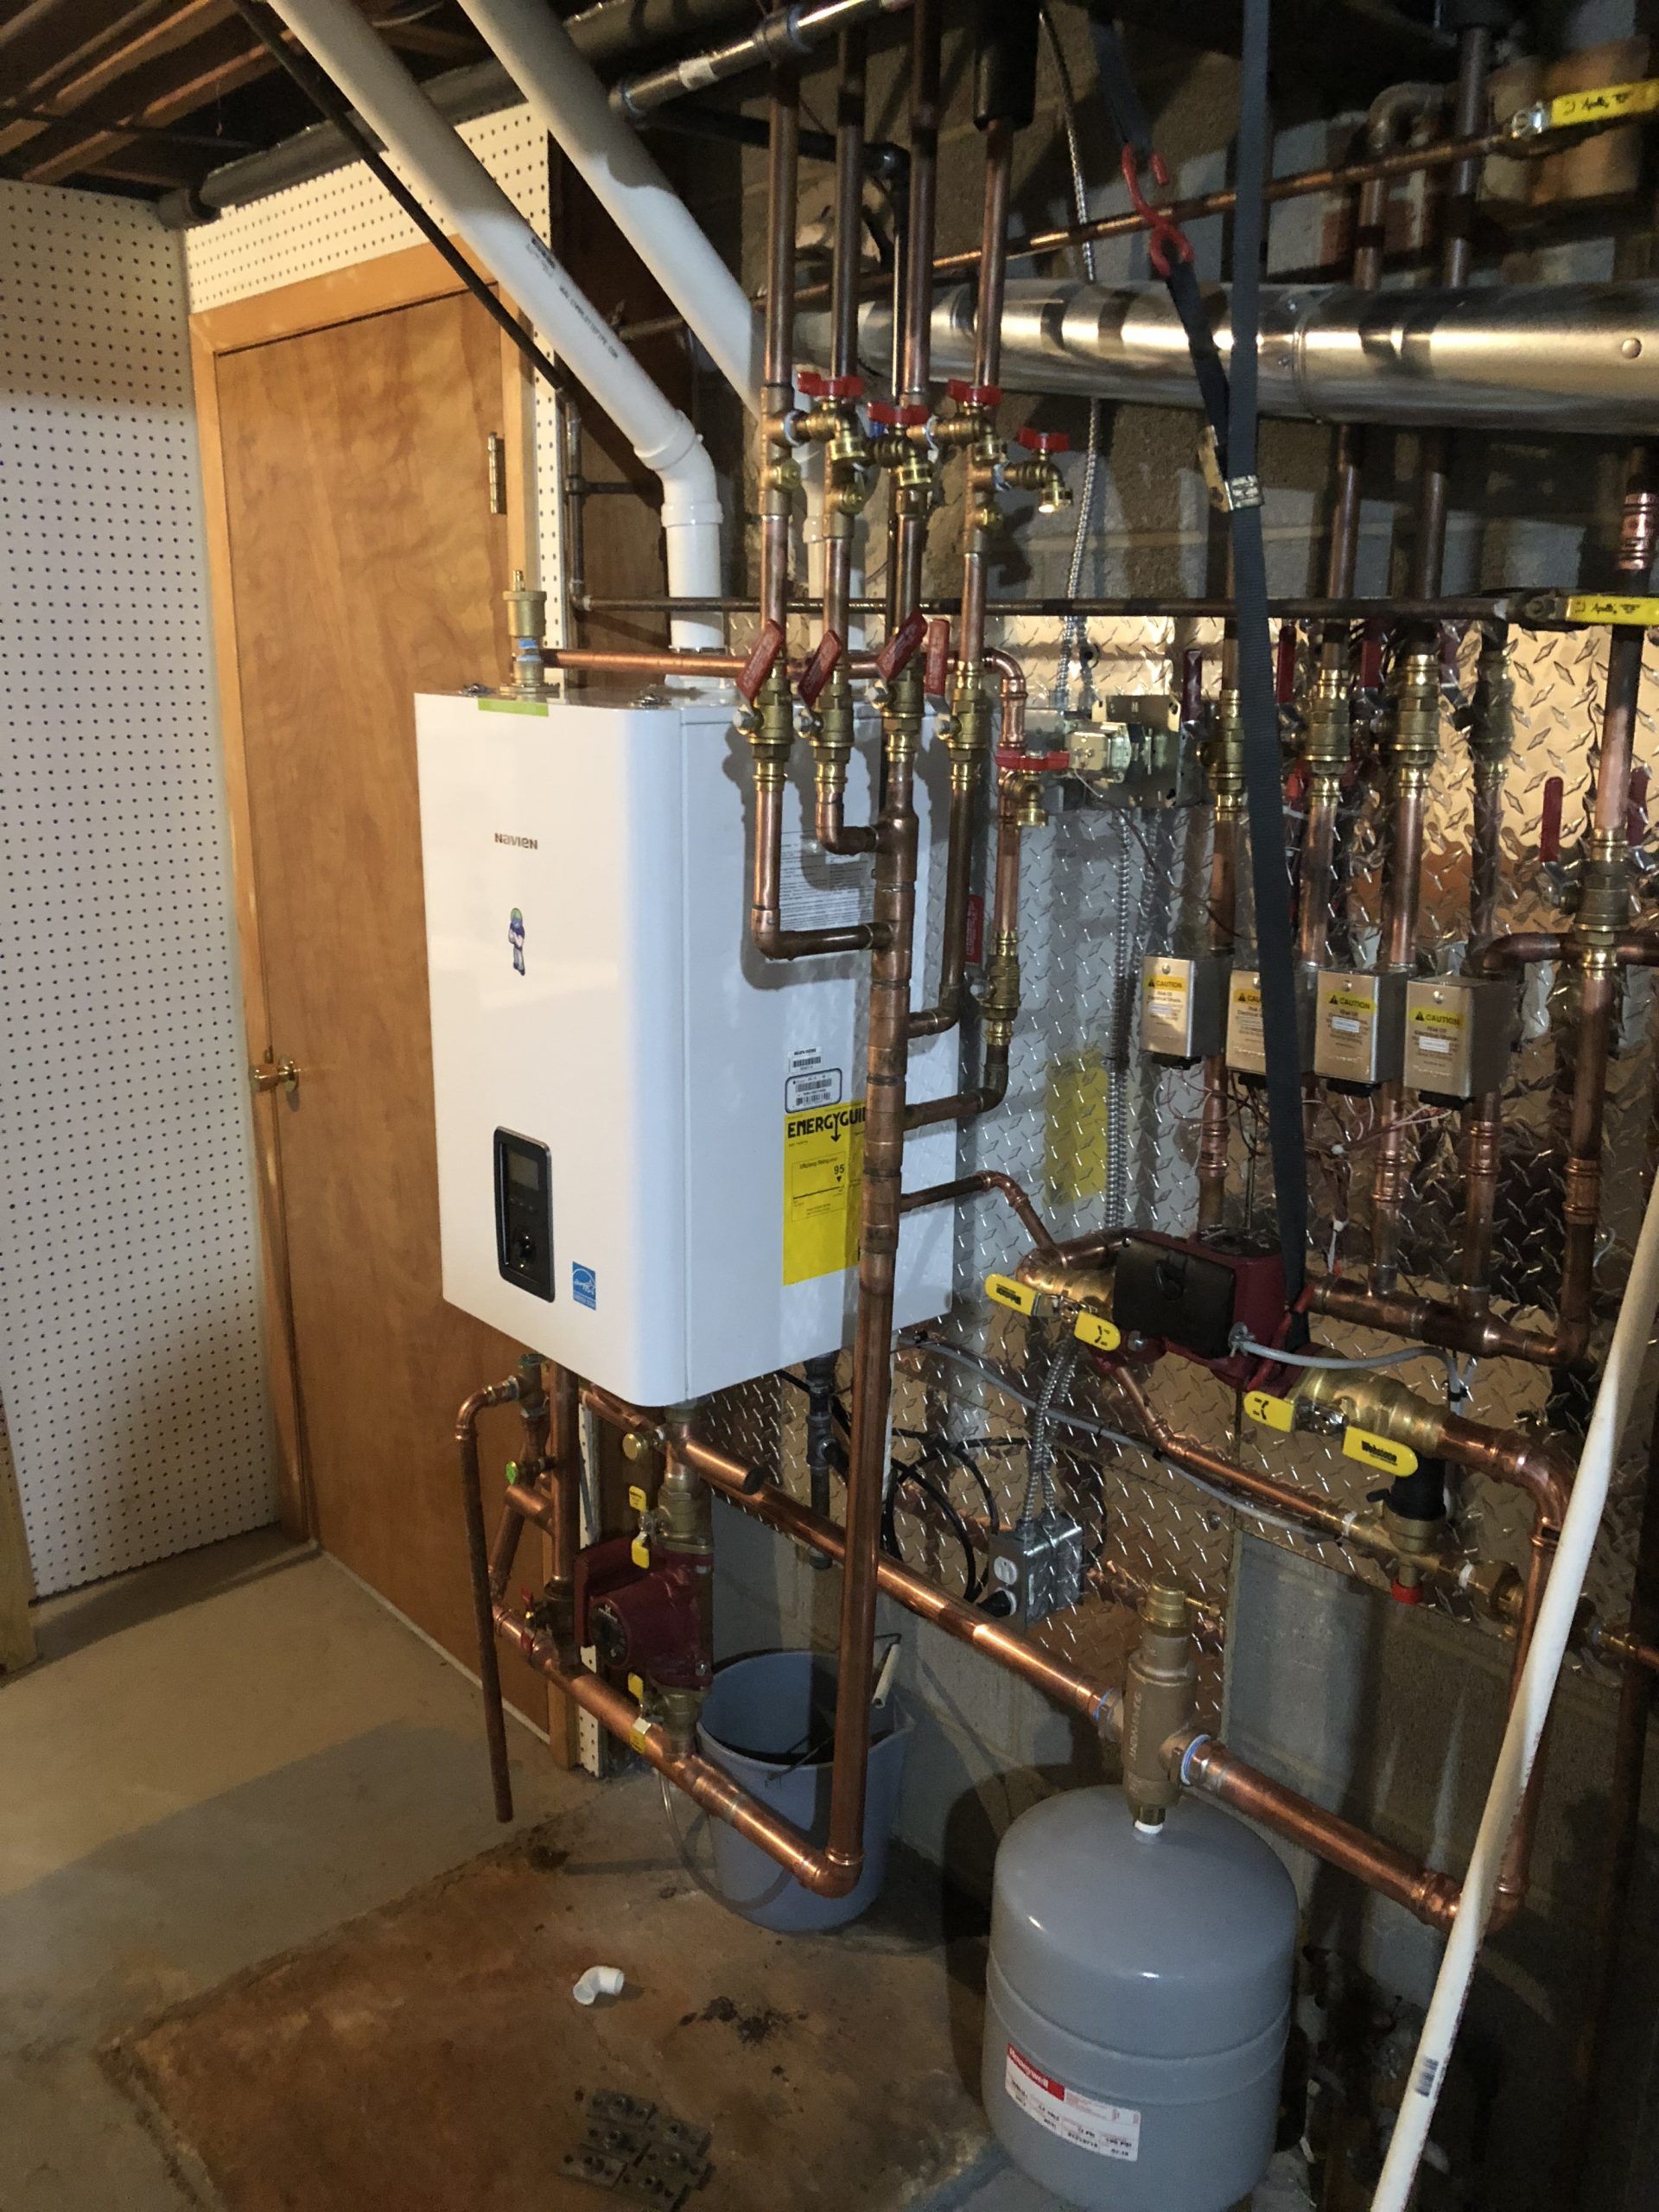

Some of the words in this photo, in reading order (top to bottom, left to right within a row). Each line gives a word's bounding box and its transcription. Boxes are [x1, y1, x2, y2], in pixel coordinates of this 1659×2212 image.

[1339, 997, 1370, 1009] CAUTION
[1426, 1014, 1460, 1026] CAUTION
[834, 1164, 845, 1175] 95
